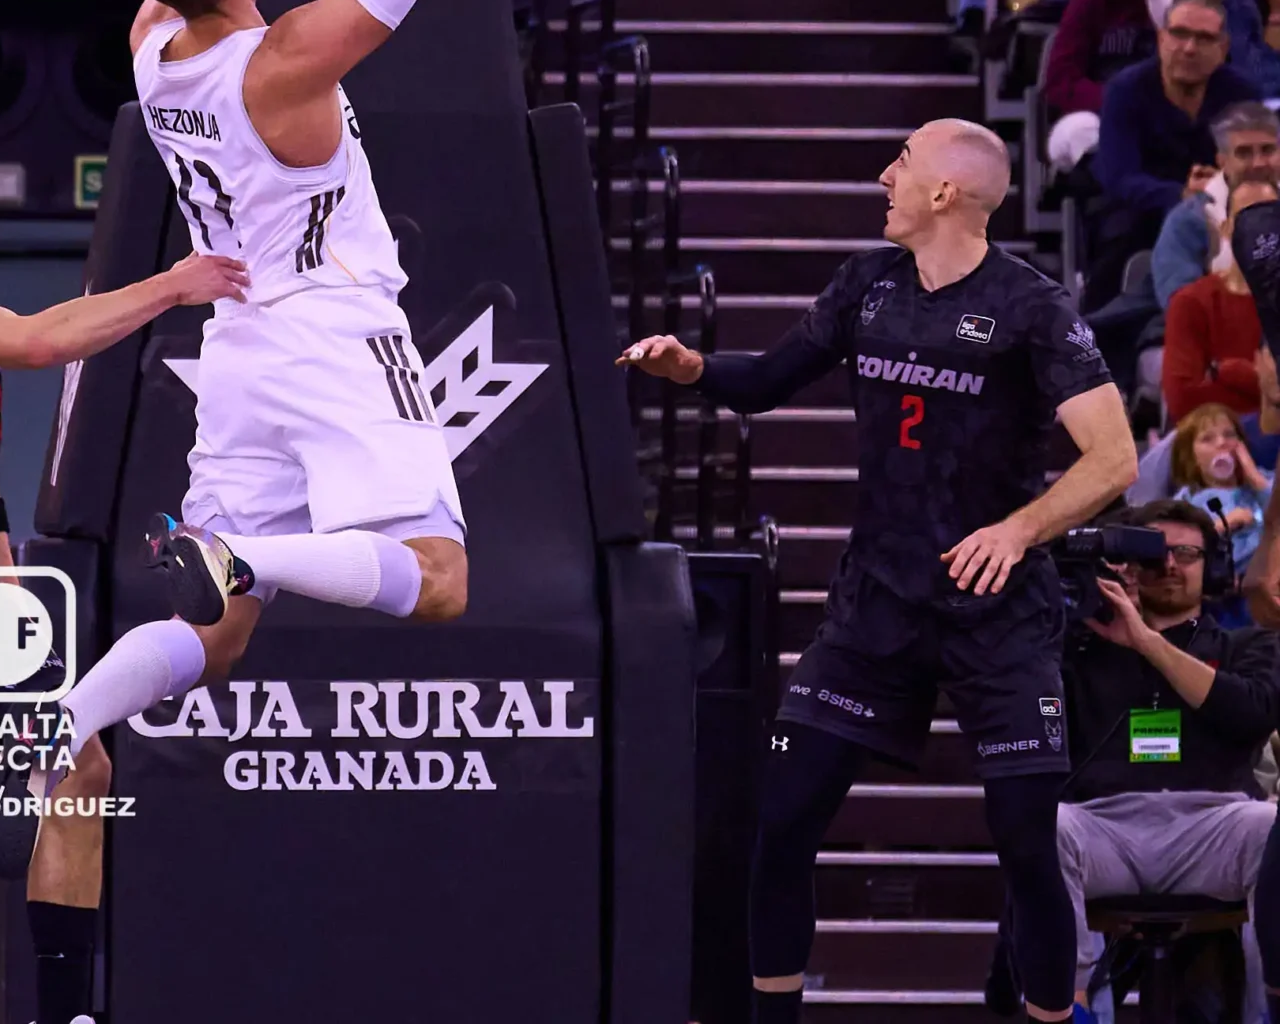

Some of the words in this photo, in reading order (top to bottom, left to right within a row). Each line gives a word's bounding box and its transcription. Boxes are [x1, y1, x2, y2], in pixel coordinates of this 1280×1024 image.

[147, 105, 221, 142] HEZONJA
[900, 395, 925, 450] 2
[330, 681, 595, 740] RURAL
[985, 739, 1040, 755] BERNER
[223, 750, 497, 792] GRANADA
